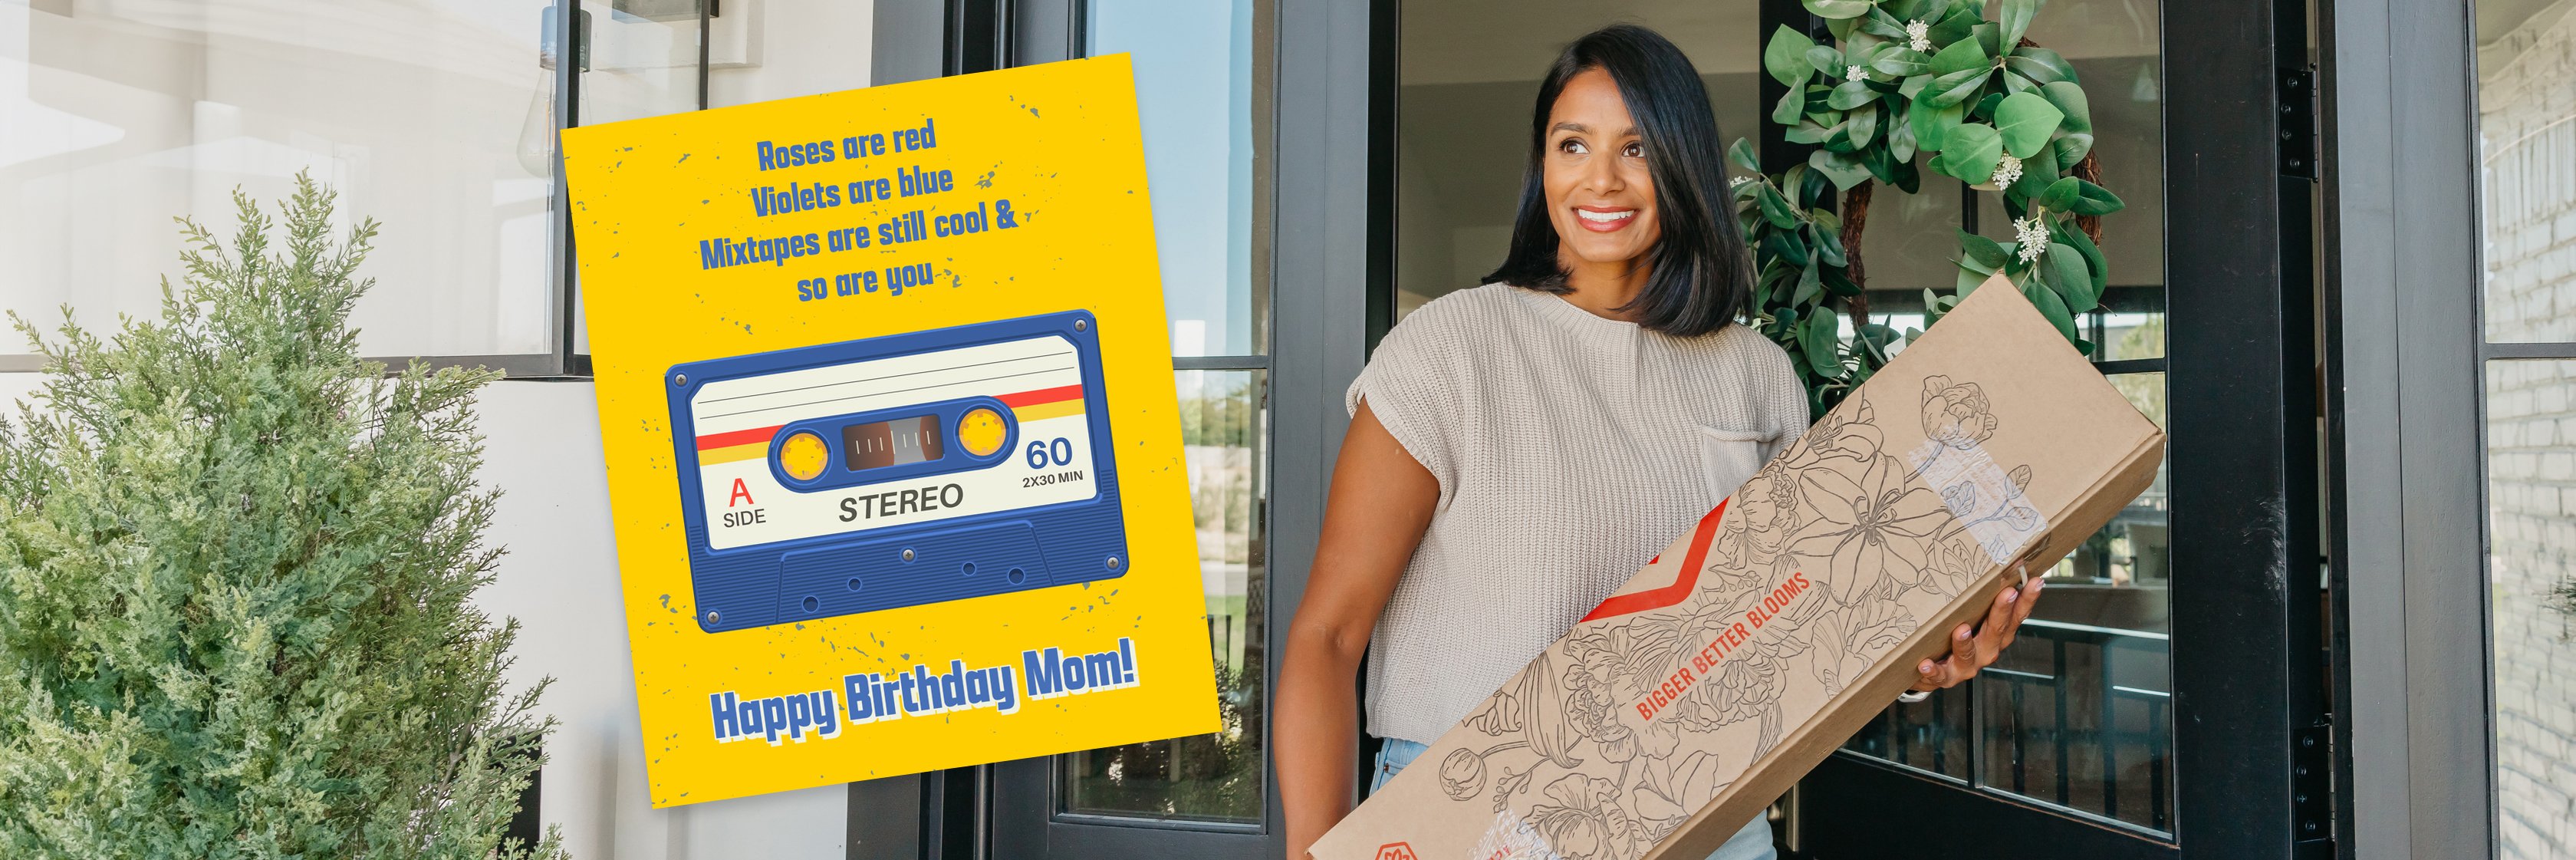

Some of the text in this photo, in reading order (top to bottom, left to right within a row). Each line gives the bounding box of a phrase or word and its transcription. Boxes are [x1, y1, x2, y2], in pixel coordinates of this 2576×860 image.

[1636, 572, 1810, 721] BIGGER BETTER BLOOMS
